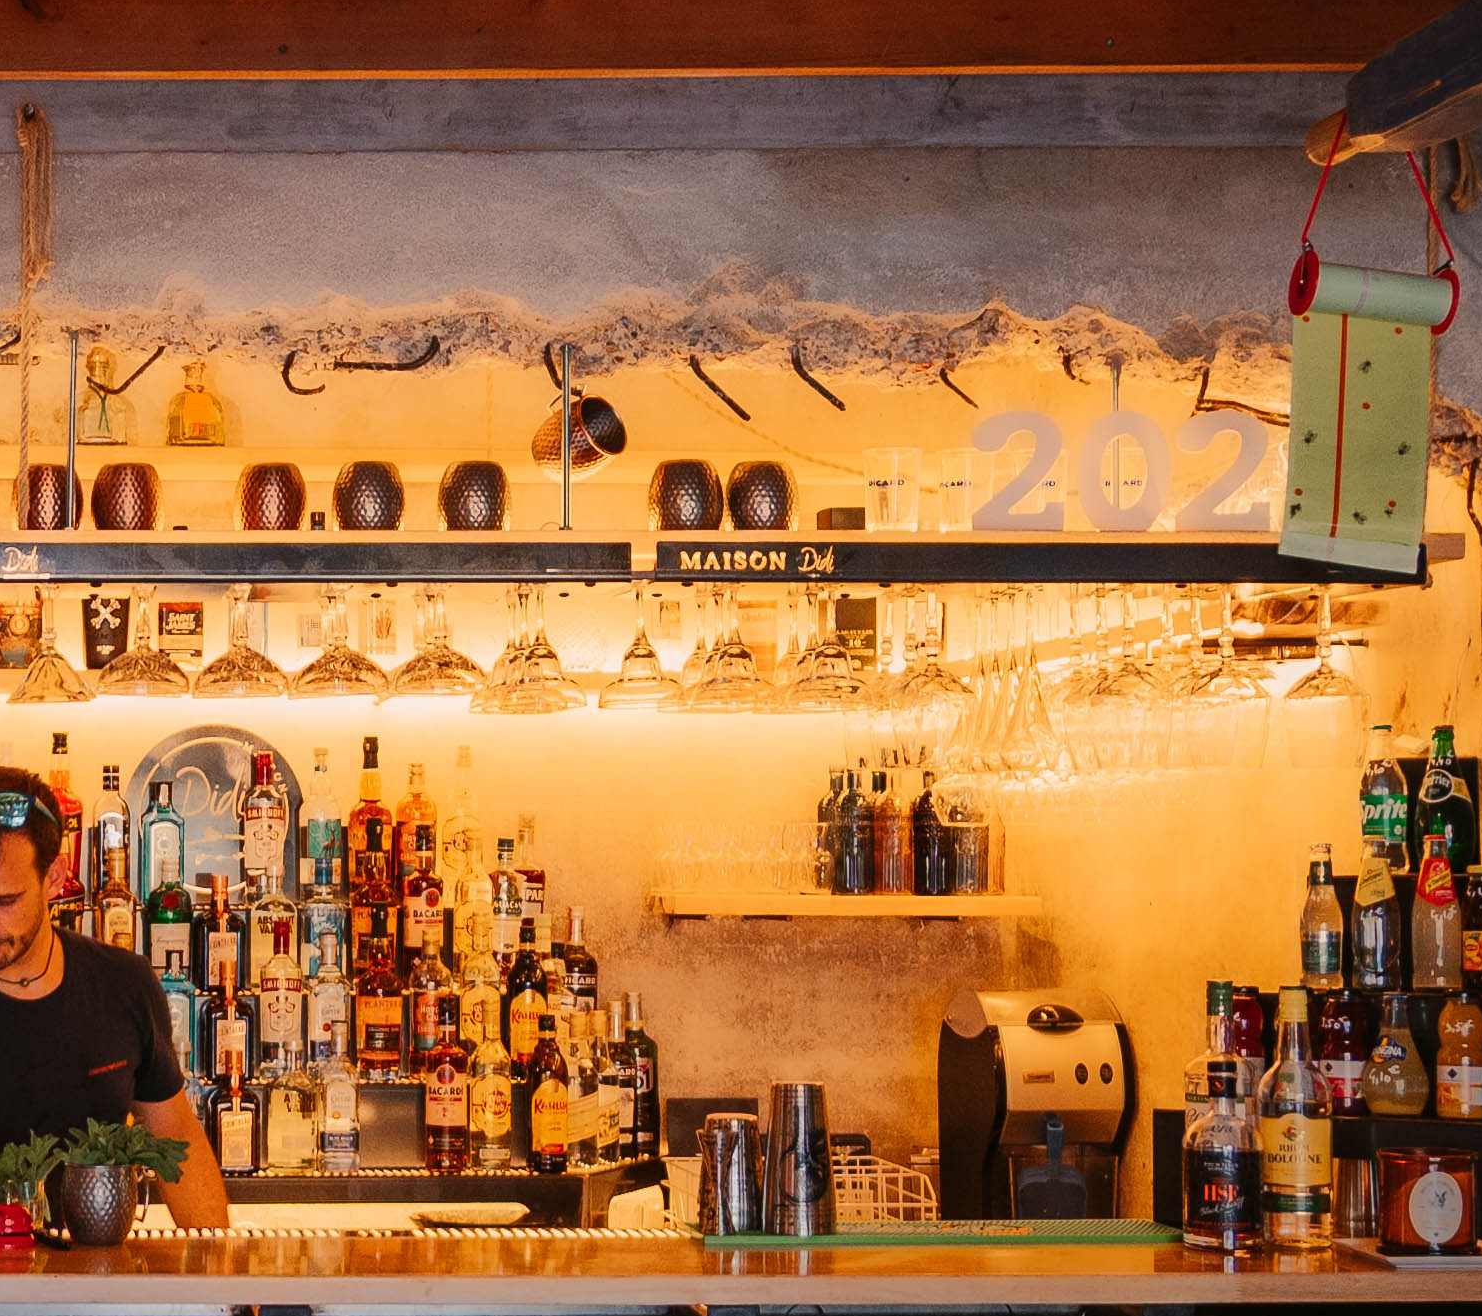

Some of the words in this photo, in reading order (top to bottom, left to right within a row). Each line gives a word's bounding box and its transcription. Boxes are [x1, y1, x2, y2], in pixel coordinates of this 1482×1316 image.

[679, 550, 787, 571] MAISON
[1360, 798, 1408, 825] Sprite
[1204, 1184, 1240, 1202] HSE
